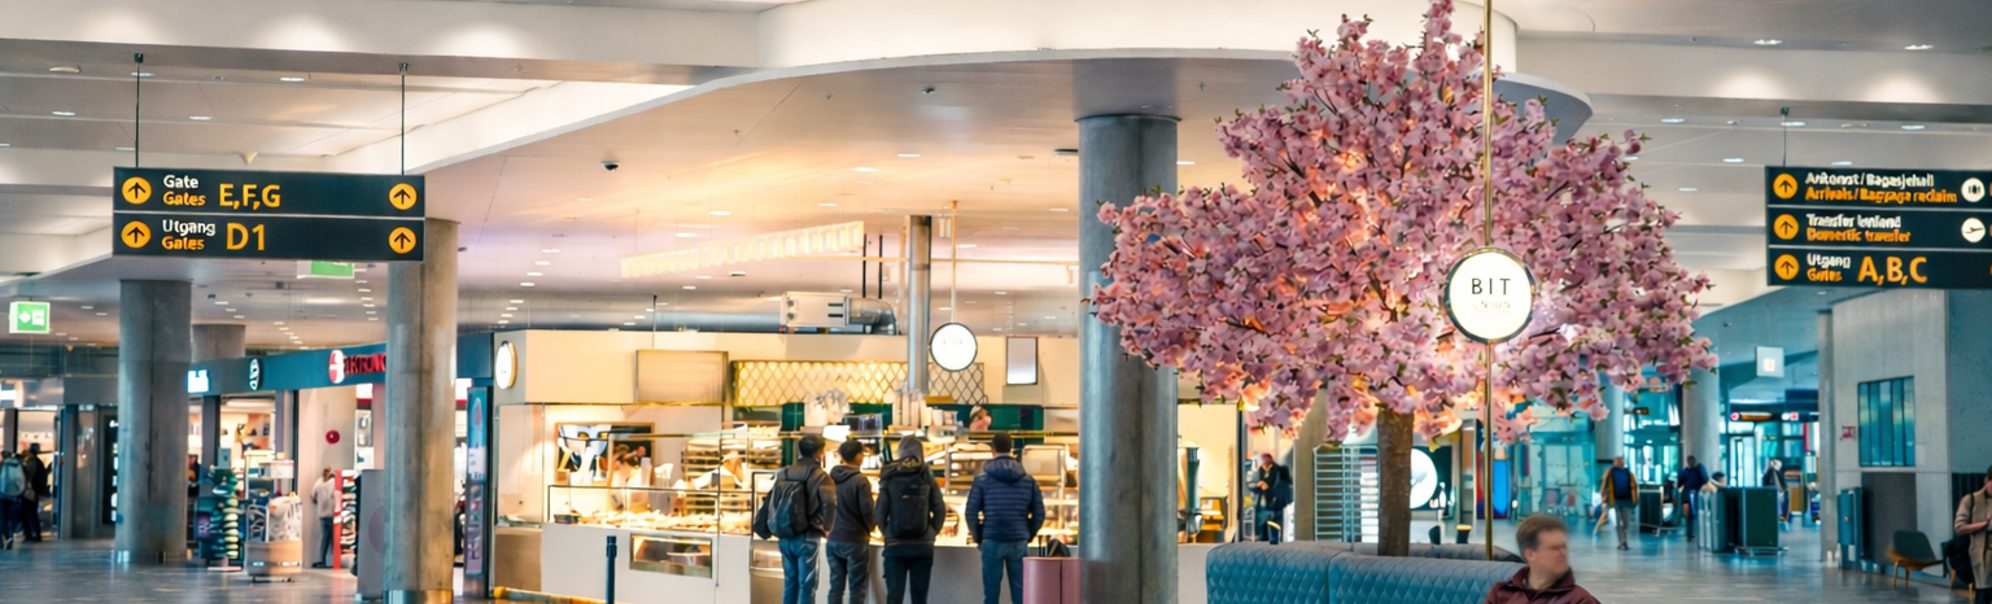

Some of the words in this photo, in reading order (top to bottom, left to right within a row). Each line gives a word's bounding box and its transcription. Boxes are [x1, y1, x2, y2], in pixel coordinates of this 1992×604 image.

[163, 174, 199, 188] Gate
[163, 191, 206, 206] Gates
[219, 183, 281, 210] E,F,G
[162, 219, 216, 236] Utgang
[1806, 213, 1855, 227] Transfer
[162, 236, 204, 250] Gates
[227, 222, 265, 250] D1
[1806, 253, 1851, 269] Utgang
[1857, 255, 1927, 285] A,B,C
[1471, 278, 1511, 295] BIT
